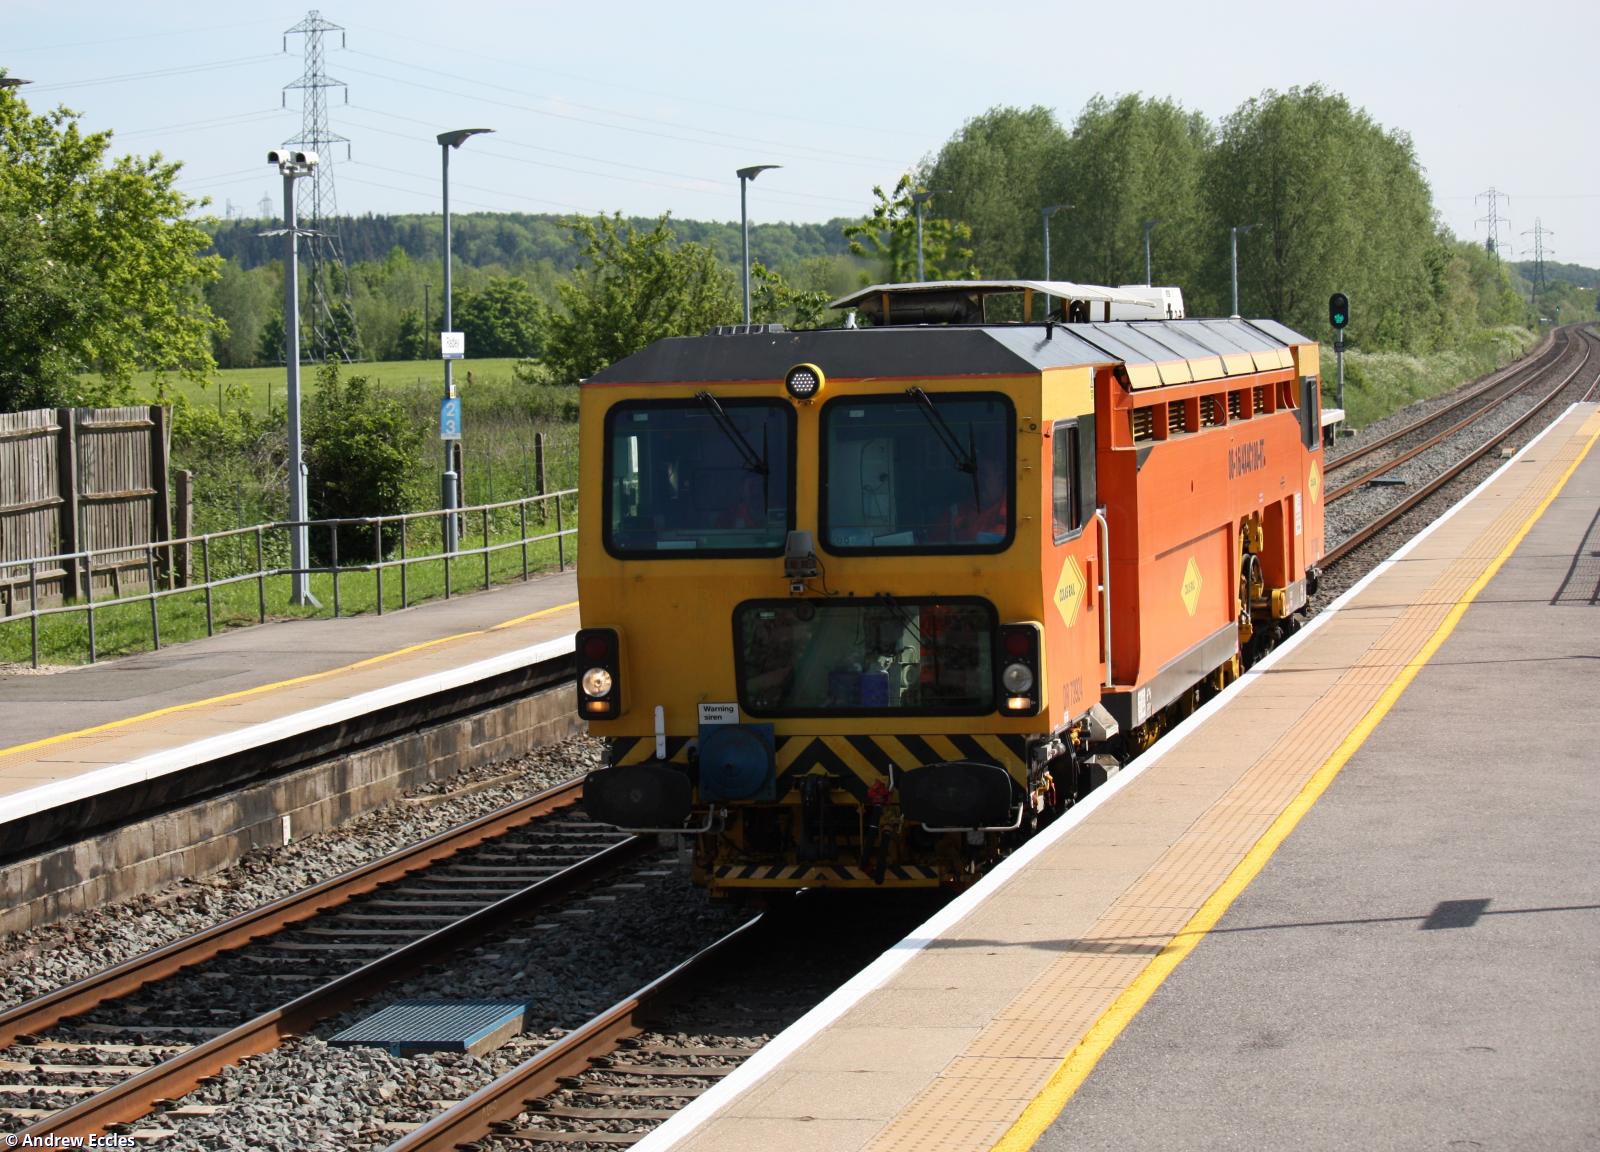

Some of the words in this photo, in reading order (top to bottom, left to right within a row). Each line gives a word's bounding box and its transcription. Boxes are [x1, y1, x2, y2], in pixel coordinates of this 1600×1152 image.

[446, 402, 456, 417] 2
[446, 419, 456, 433] 3
[703, 705, 734, 713] Warning
